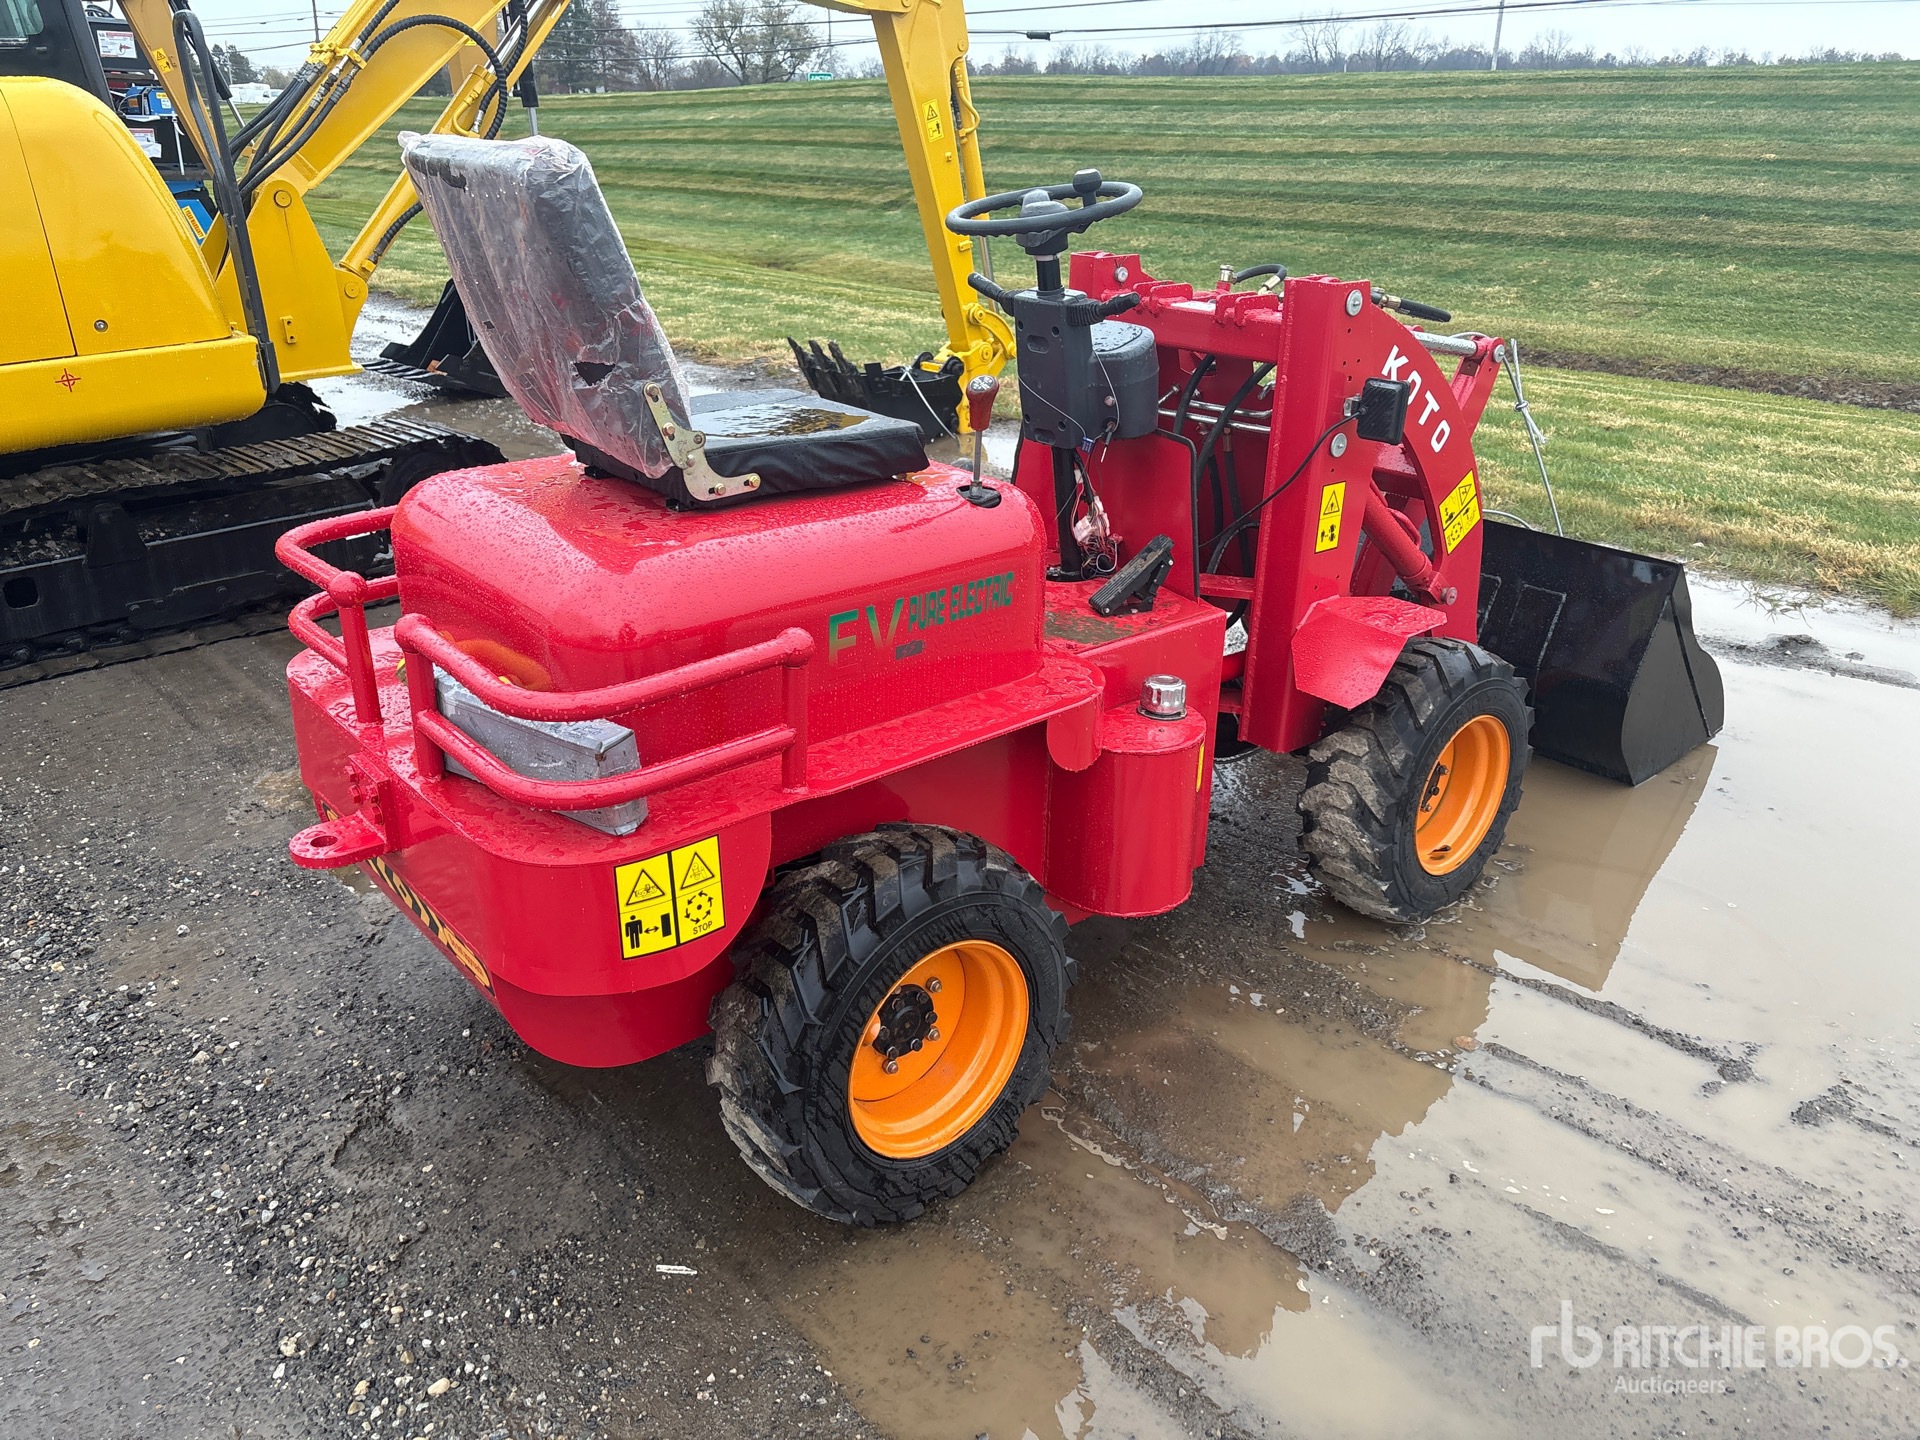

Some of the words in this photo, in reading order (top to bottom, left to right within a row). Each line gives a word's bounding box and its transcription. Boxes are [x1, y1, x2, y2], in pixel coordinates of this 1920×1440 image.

[184, 209, 194, 220] YEAR
[190, 218, 204, 238] WARRANTY
[908, 588, 947, 632] PURE
[950, 571, 1014, 622] ELECTRIC
[693, 920, 713, 935] STOP
